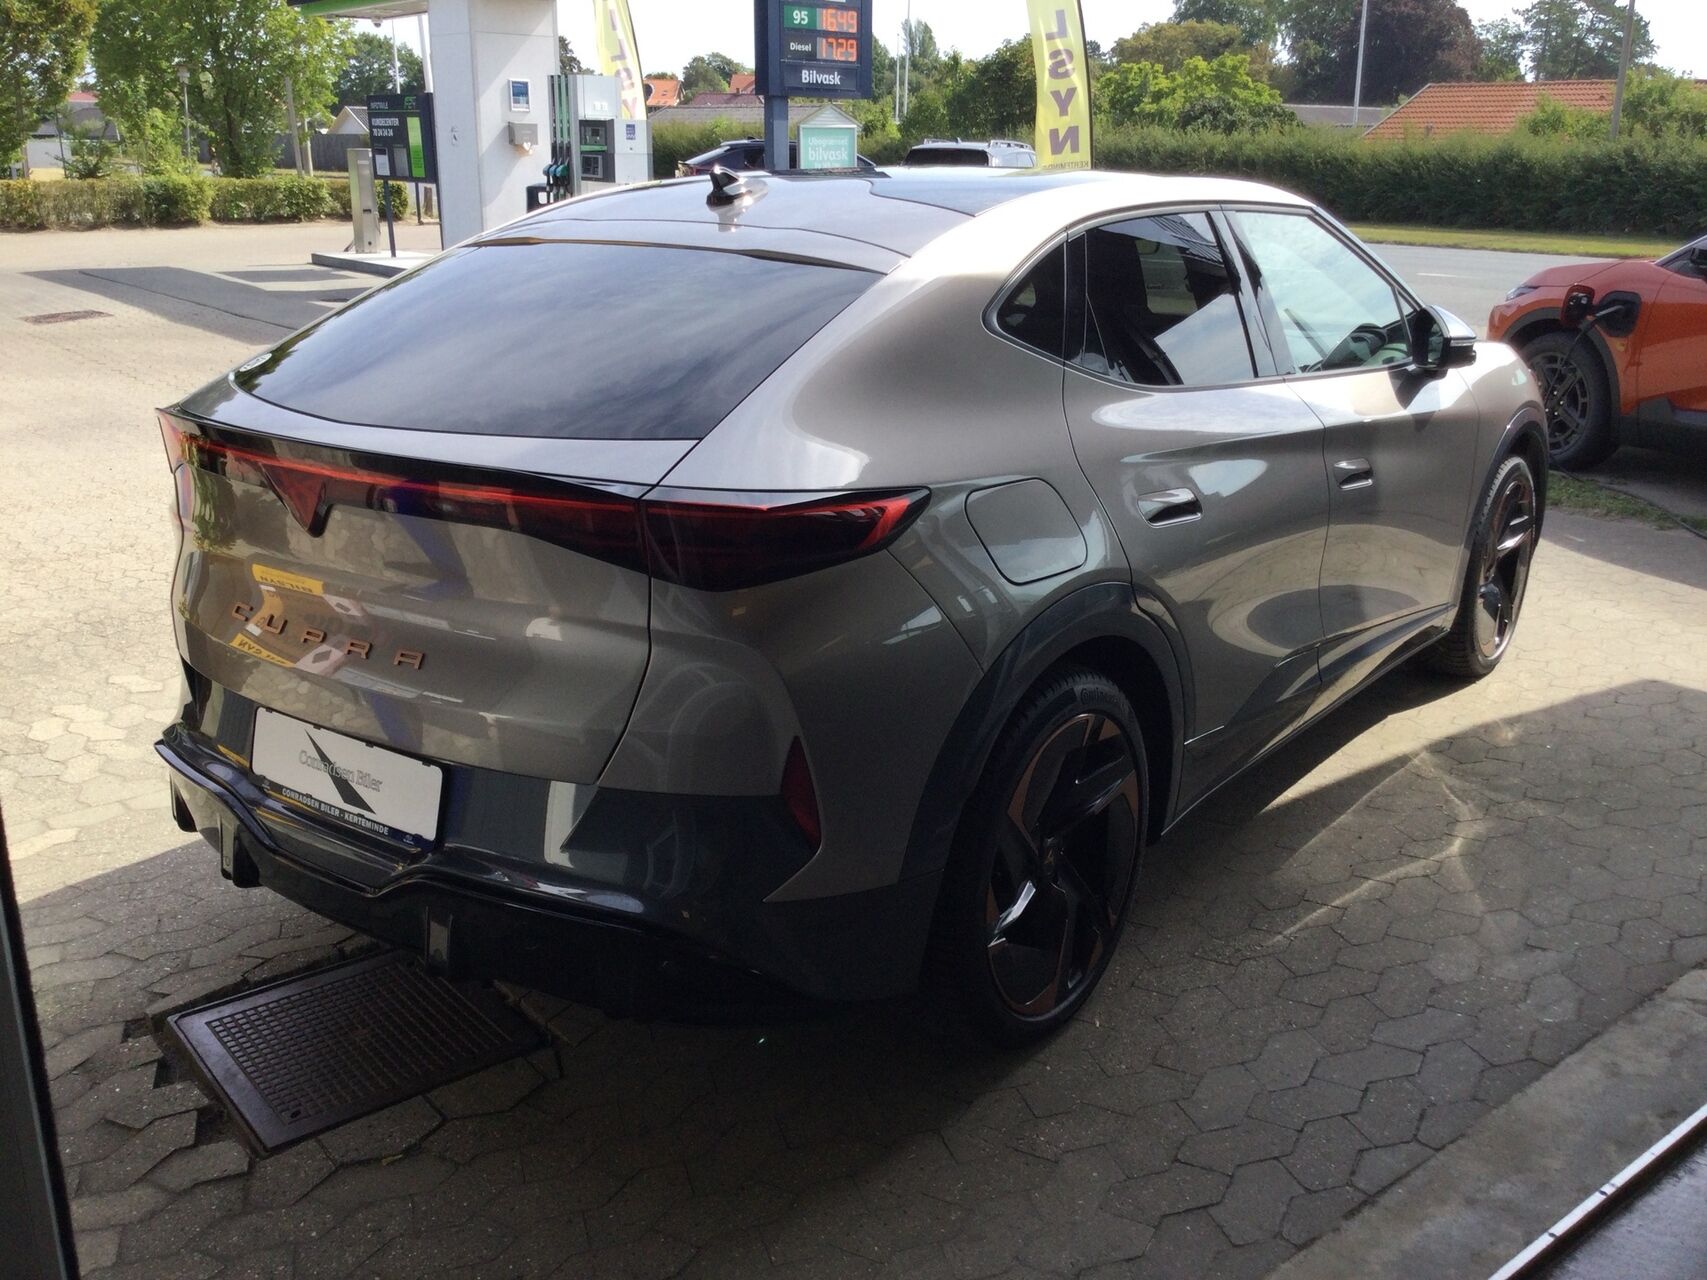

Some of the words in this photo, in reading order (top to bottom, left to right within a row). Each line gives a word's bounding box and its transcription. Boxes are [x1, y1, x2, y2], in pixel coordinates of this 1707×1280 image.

[792, 10, 809, 25] 95
[789, 42, 812, 52] Diesel
[801, 69, 841, 85] Bilvask
[808, 147, 849, 161] bilvask
[231, 601, 426, 671] CUPRA
[298, 749, 355, 783] Conradsen
[355, 769, 383, 793] Biler
[282, 787, 320, 811] CONRADSEN
[320, 801, 340, 818] BILER
[344, 809, 389, 835] KERTEMINDE
